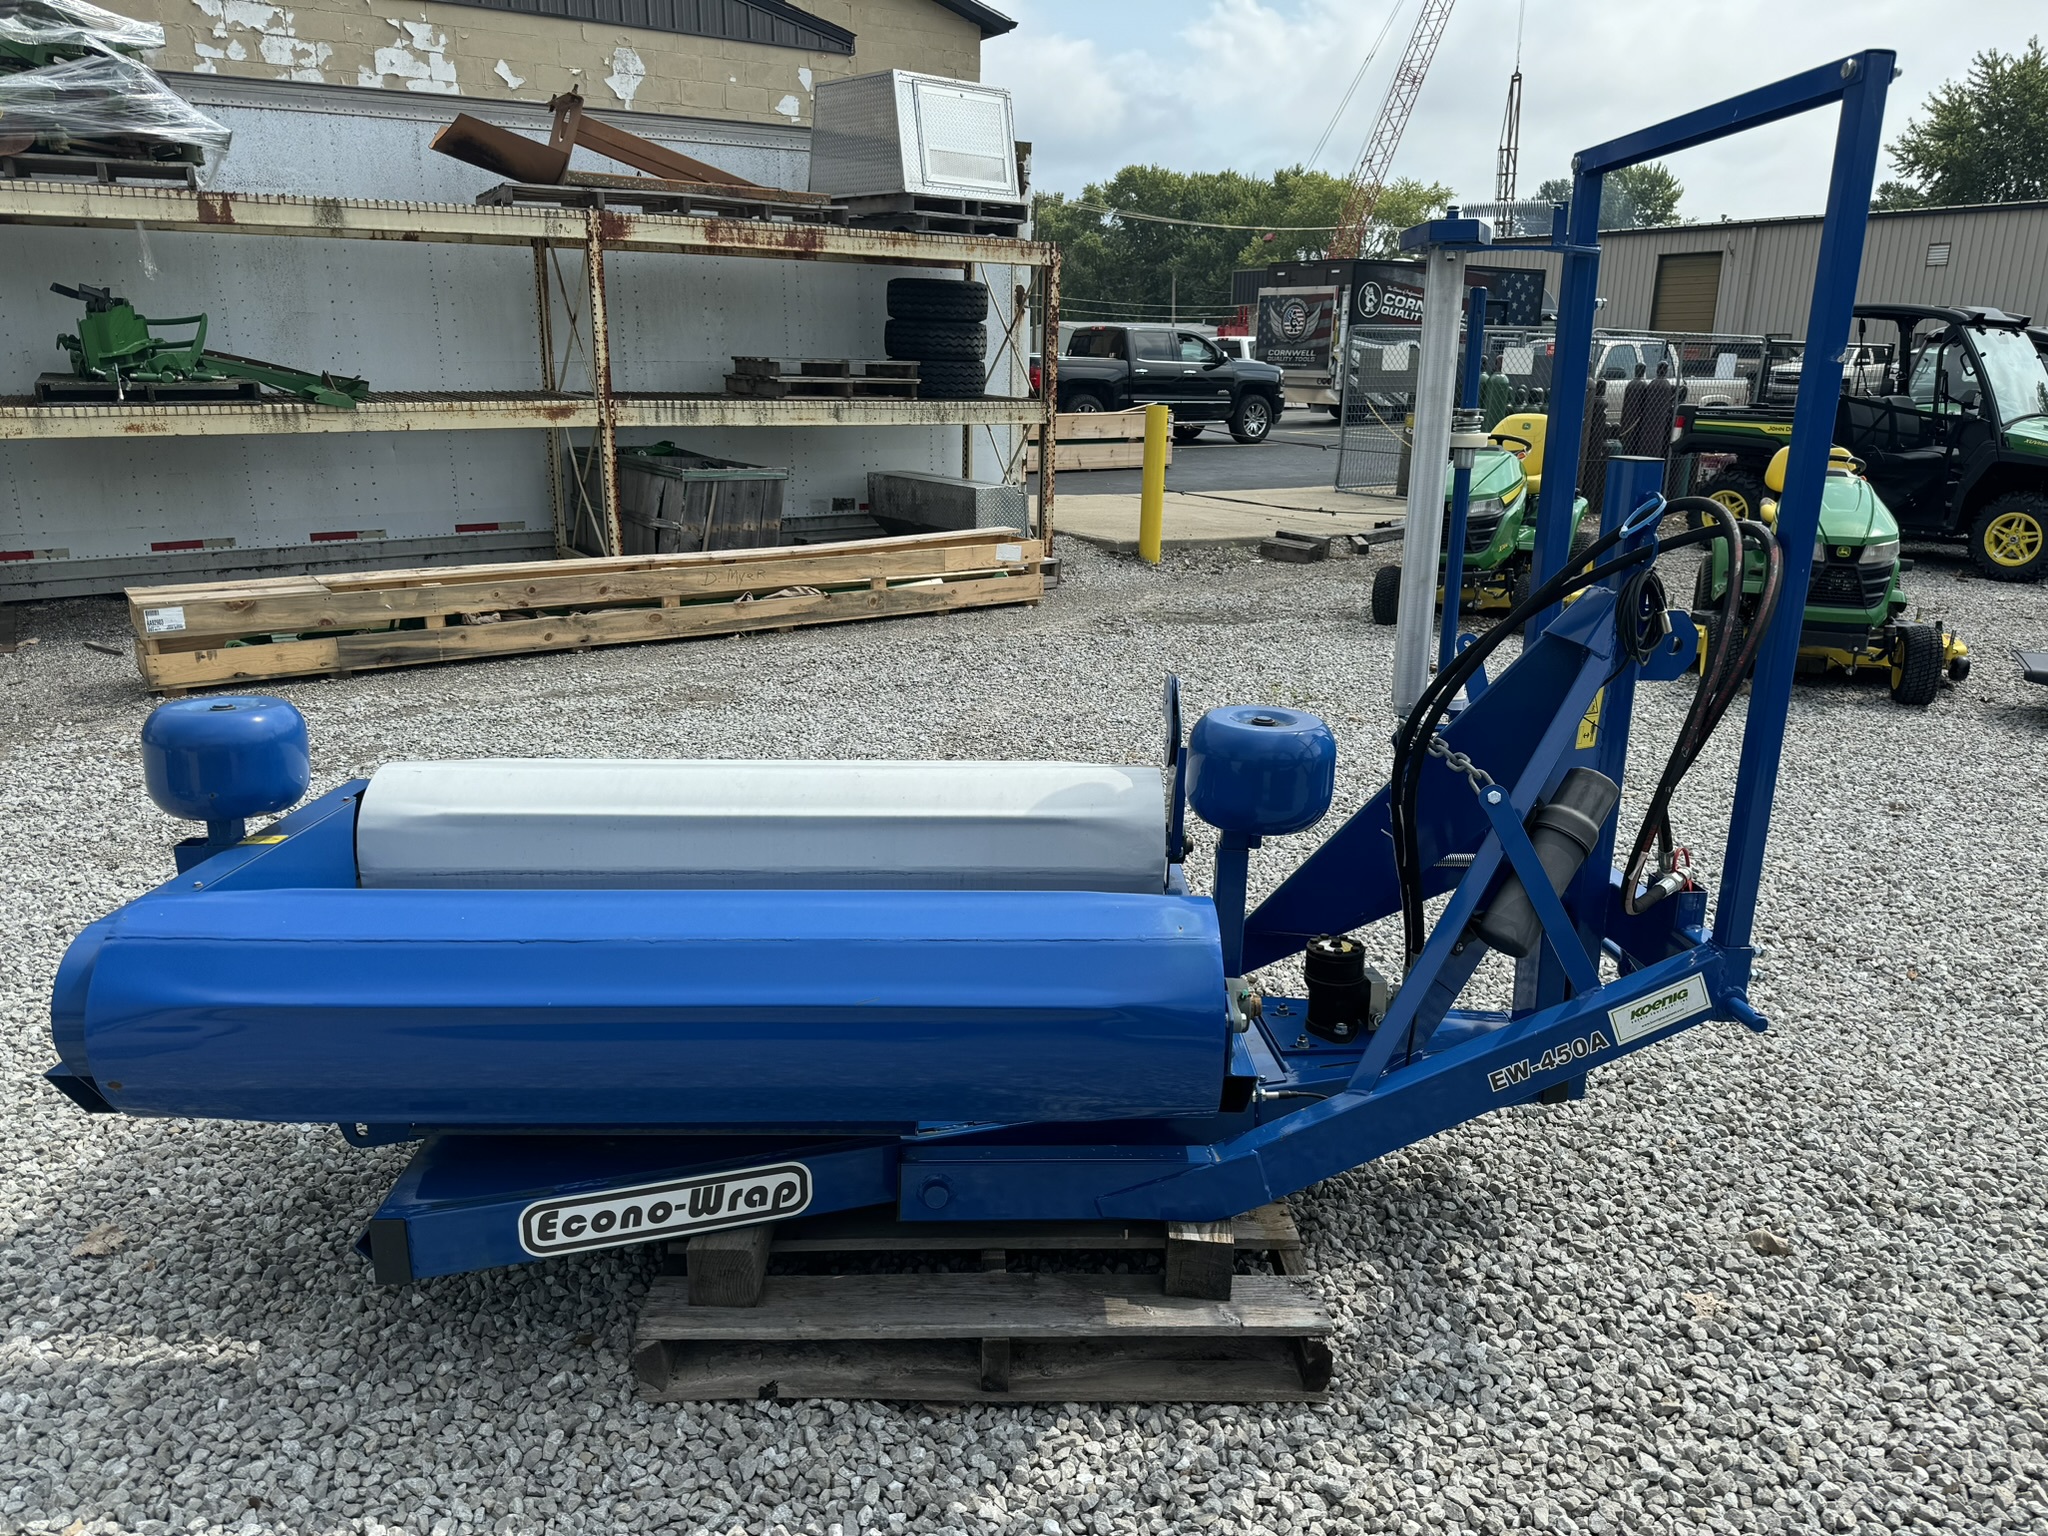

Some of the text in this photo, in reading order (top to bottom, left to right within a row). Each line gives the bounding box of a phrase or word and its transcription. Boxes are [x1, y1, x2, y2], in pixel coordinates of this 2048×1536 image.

[1268, 349, 1316, 357] CORNWELL
[1488, 1030, 1610, 1092] EW-450A
[536, 1180, 798, 1242] Econo-Wrap
